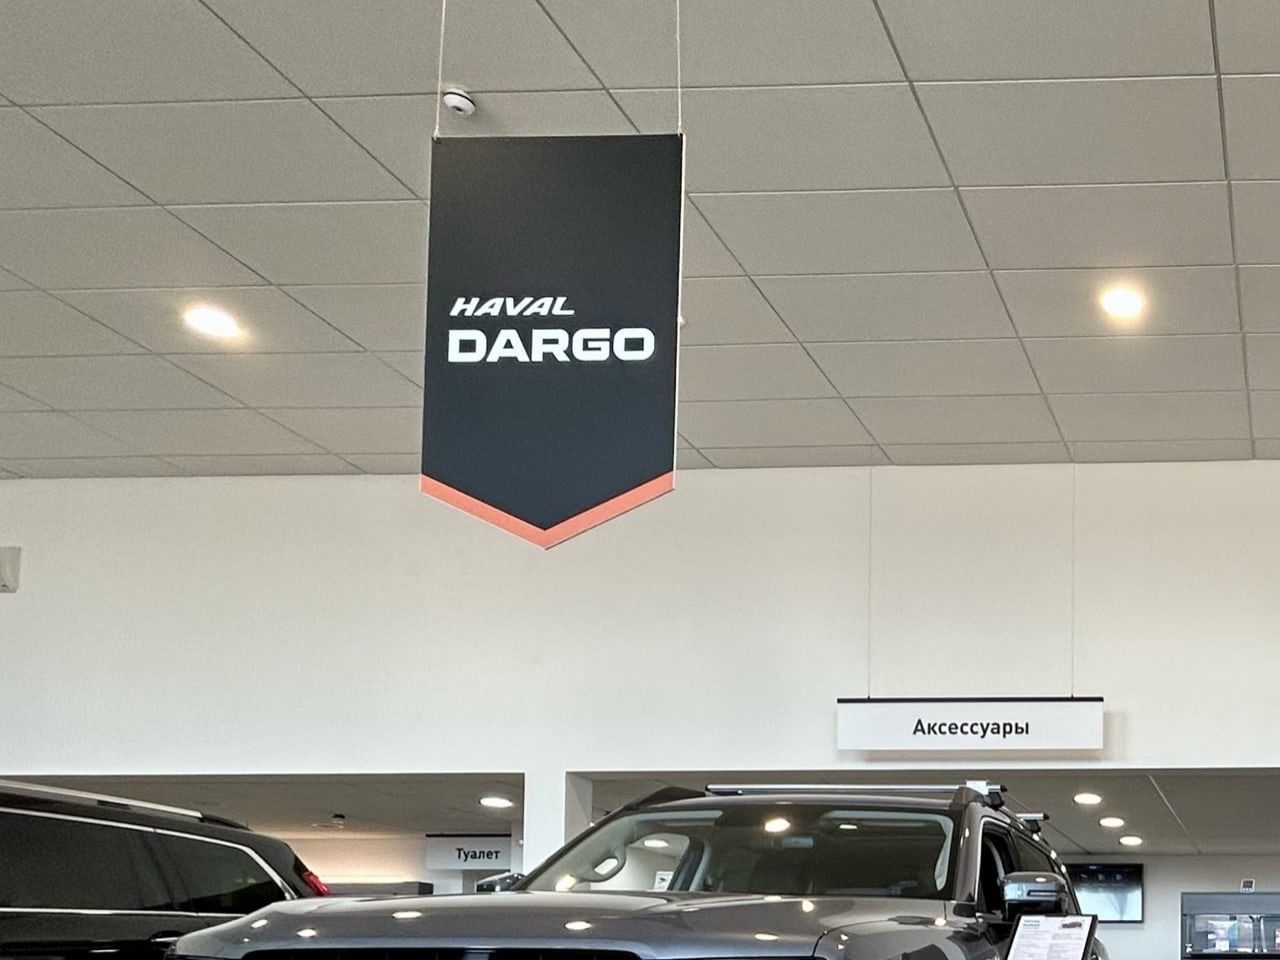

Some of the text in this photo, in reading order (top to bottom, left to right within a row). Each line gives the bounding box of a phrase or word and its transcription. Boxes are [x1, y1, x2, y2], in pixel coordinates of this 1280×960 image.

[450, 297, 575, 316] HAVAL
[447, 328, 655, 362] DARGO
[912, 718, 1030, 739] Аксессуары
[456, 848, 501, 862] Туалет
